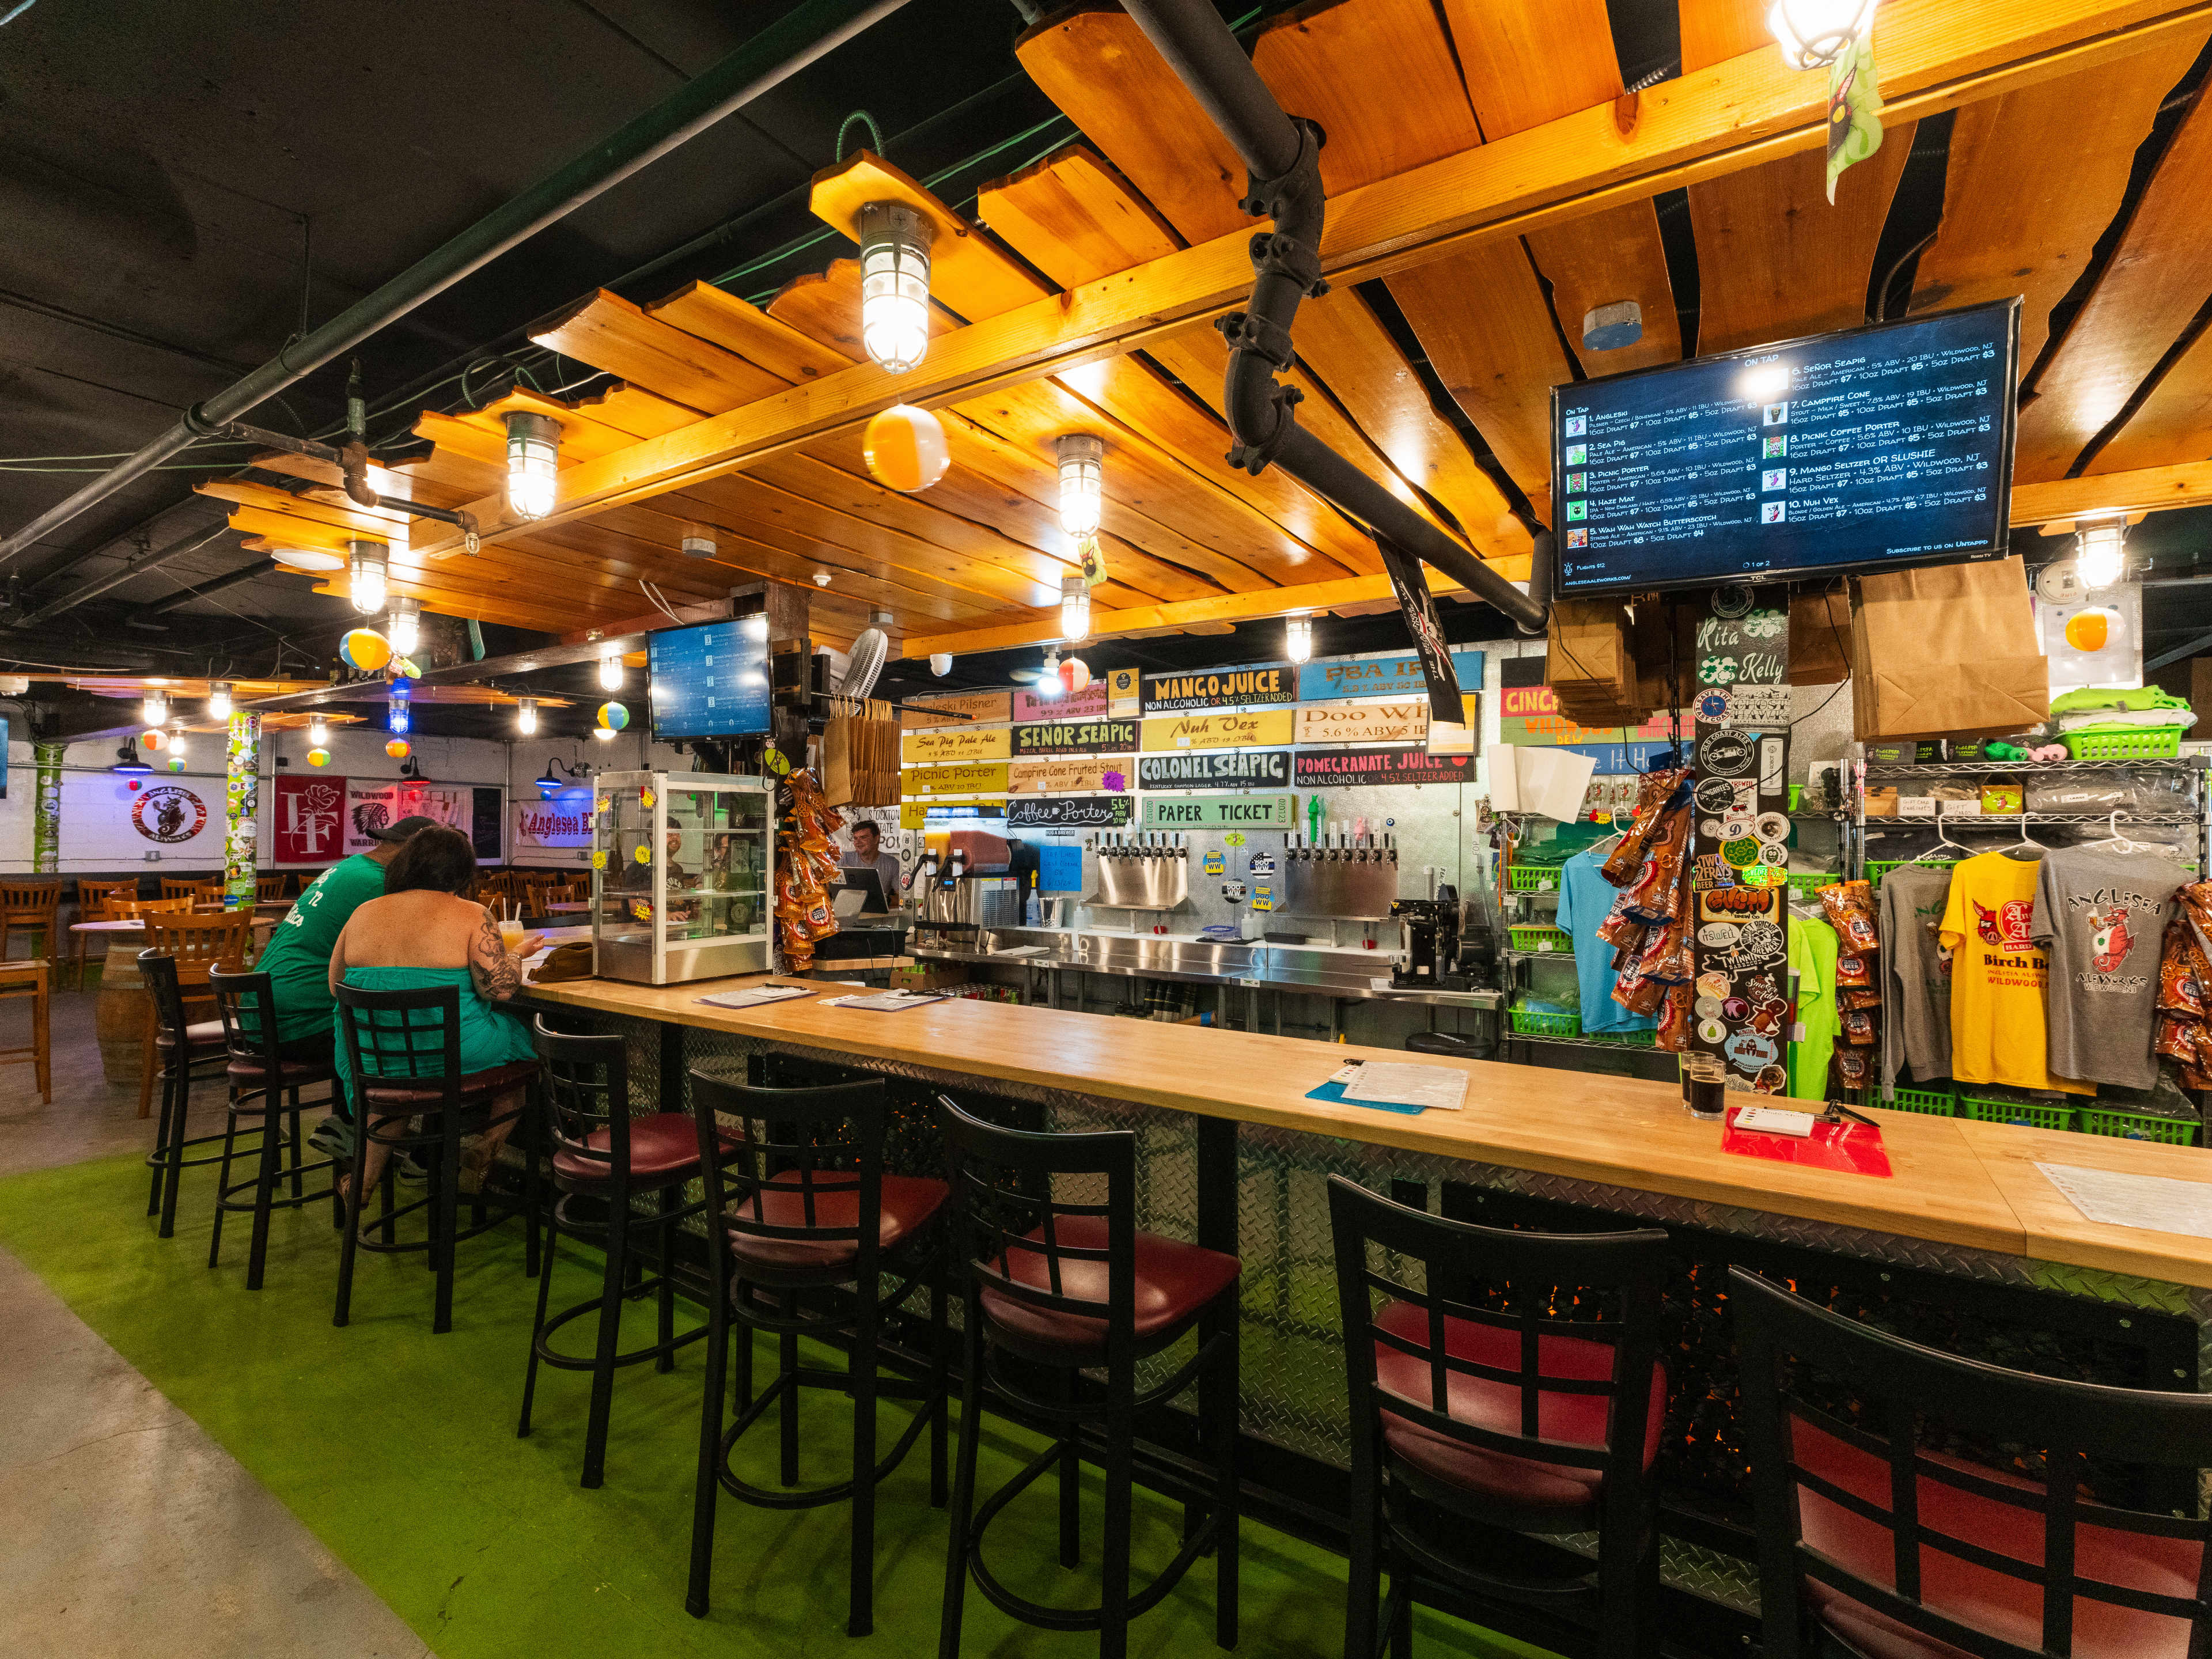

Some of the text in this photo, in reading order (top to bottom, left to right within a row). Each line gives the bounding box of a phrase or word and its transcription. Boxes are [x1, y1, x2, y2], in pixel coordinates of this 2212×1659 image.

[1745, 354, 1779, 367] ON TAP
[1697, 617, 1740, 652] Rita
[1739, 652, 1783, 684] Kelly
[1155, 670, 1281, 701] MANGO JUICE
[960, 698, 997, 710] Pilsner
[1145, 701, 1162, 711] NON
[1163, 698, 1209, 710] ALCOHOLIC
[1211, 697, 1221, 706] OR
[1240, 693, 1270, 704] SELTZER
[1270, 692, 1293, 702] ADDED
[1697, 691, 1731, 704] SAVE THE
[1734, 700, 1789, 710] GHOST
[1305, 710, 1366, 722] Doo
[1695, 707, 1710, 721] EAST
[1733, 711, 1789, 720] HAWK
[1323, 728, 1341, 737] 5.6
[1363, 726, 1396, 736] ABV
[1400, 726, 1408, 734] 5
[916, 733, 995, 748] Sea Pig Pale Ale
[1556, 734, 1584, 745] DEW
[1702, 731, 1749, 751] OLD COAST ALES
[1049, 765, 1066, 777] Cone
[1069, 763, 1097, 775] Fruited
[1099, 762, 1123, 774] Stout
[1141, 754, 1284, 781] COLONEL SEAPIG
[1298, 752, 1442, 773] POMEGRANATE JUICE
[1707, 763, 1717, 772] Saint
[1740, 757, 1751, 770] Florida
[911, 767, 997, 781] Picnic Porter
[1297, 775, 1315, 785] NON
[1316, 774, 1366, 785] ALCOHOLIC
[1403, 771, 1438, 782] SELTZER
[1440, 771, 1464, 781] ADDED
[350, 791, 393, 800] WILDWOOD
[868, 809, 900, 820] STOCKTON
[1007, 799, 1113, 822] Coffee Porter
[1159, 804, 1272, 821] PAPER TICKET
[528, 813, 578, 838] Anglesea
[1701, 854, 1722, 867] TWO
[902, 877, 909, 885] 40
[309, 891, 323, 907] 12
[2067, 888, 2161, 915] ANGLESEA
[1742, 921, 1779, 944] BUCKET BRIGADE
[1752, 937, 1781, 955] BREWERY
[1729, 960, 1762, 969] BARBECUE
[1984, 955, 2028, 968] Birch
